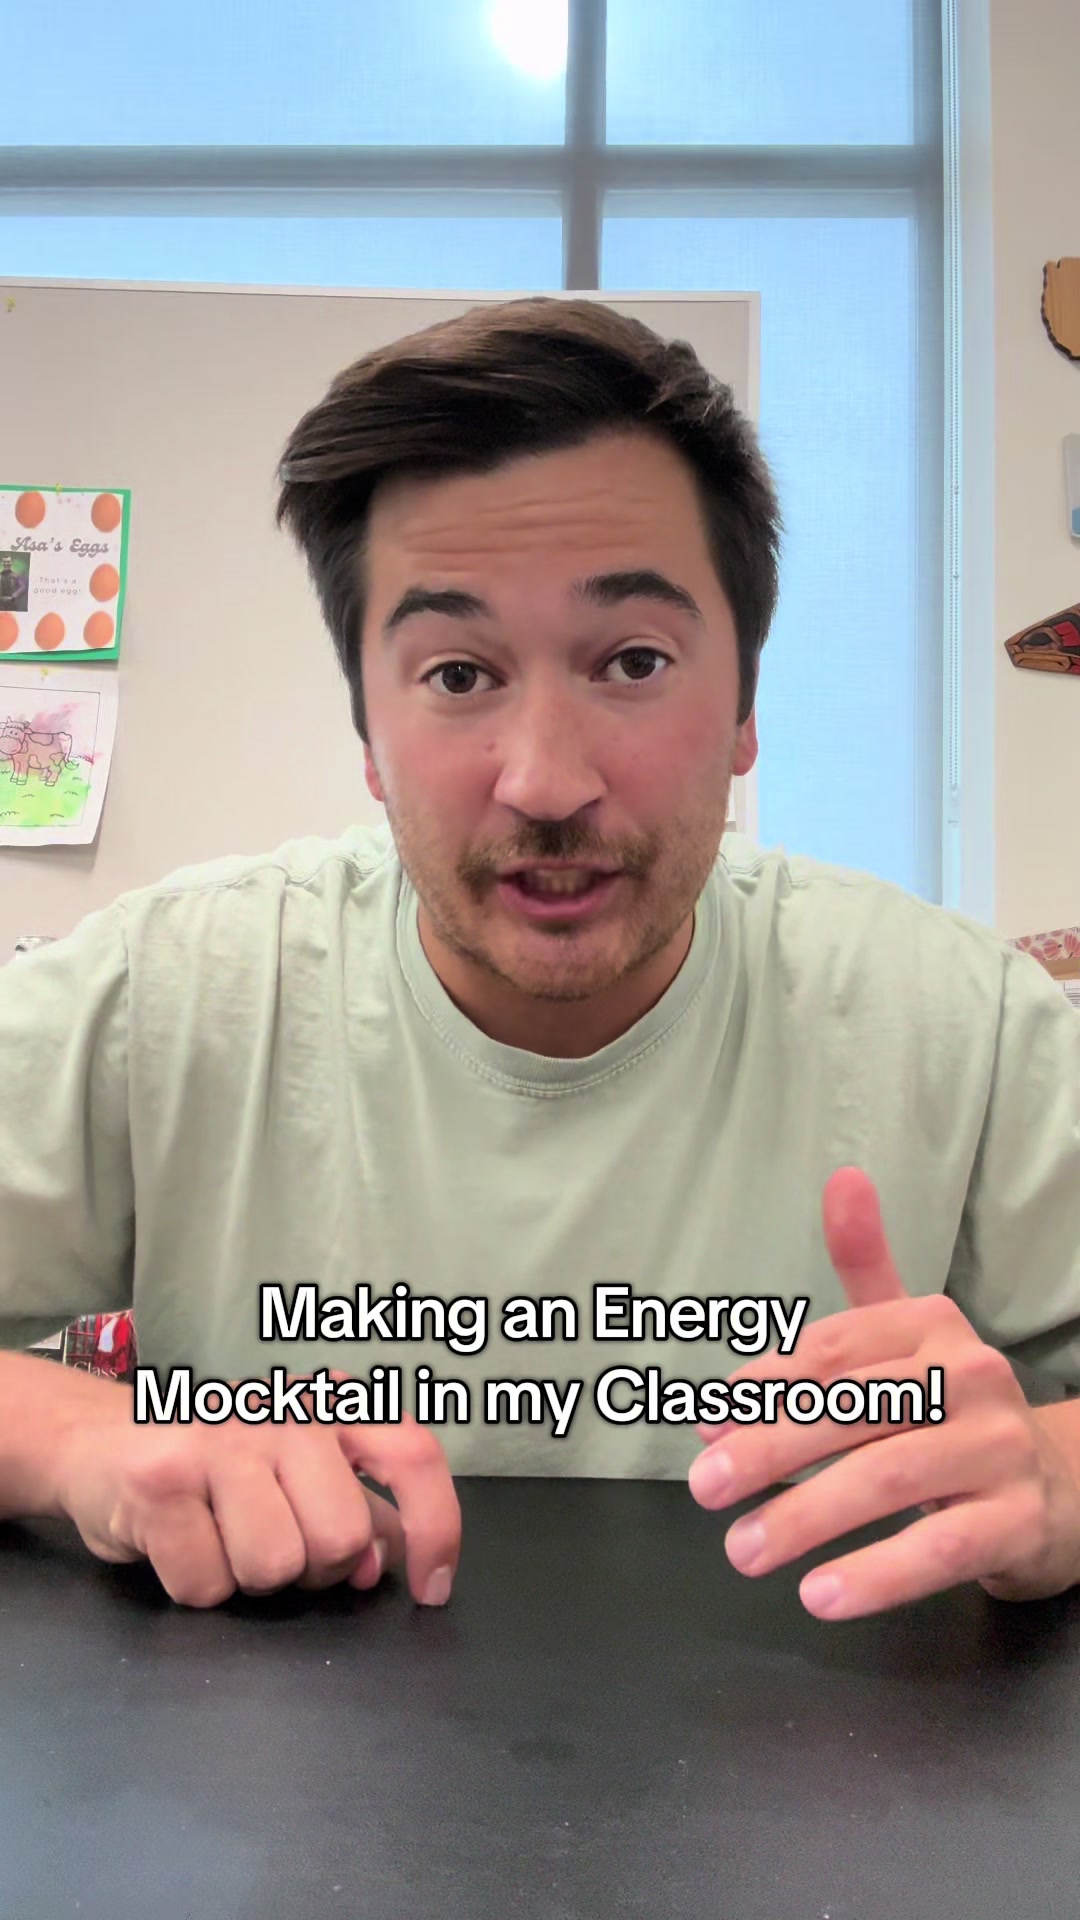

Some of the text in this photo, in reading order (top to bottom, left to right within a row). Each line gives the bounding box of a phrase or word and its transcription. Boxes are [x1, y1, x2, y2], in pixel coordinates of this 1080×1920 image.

[10, 536, 109, 558] Asa's Eggs
[39, 577, 69, 585] That's
[60, 588, 81, 596] egg!
